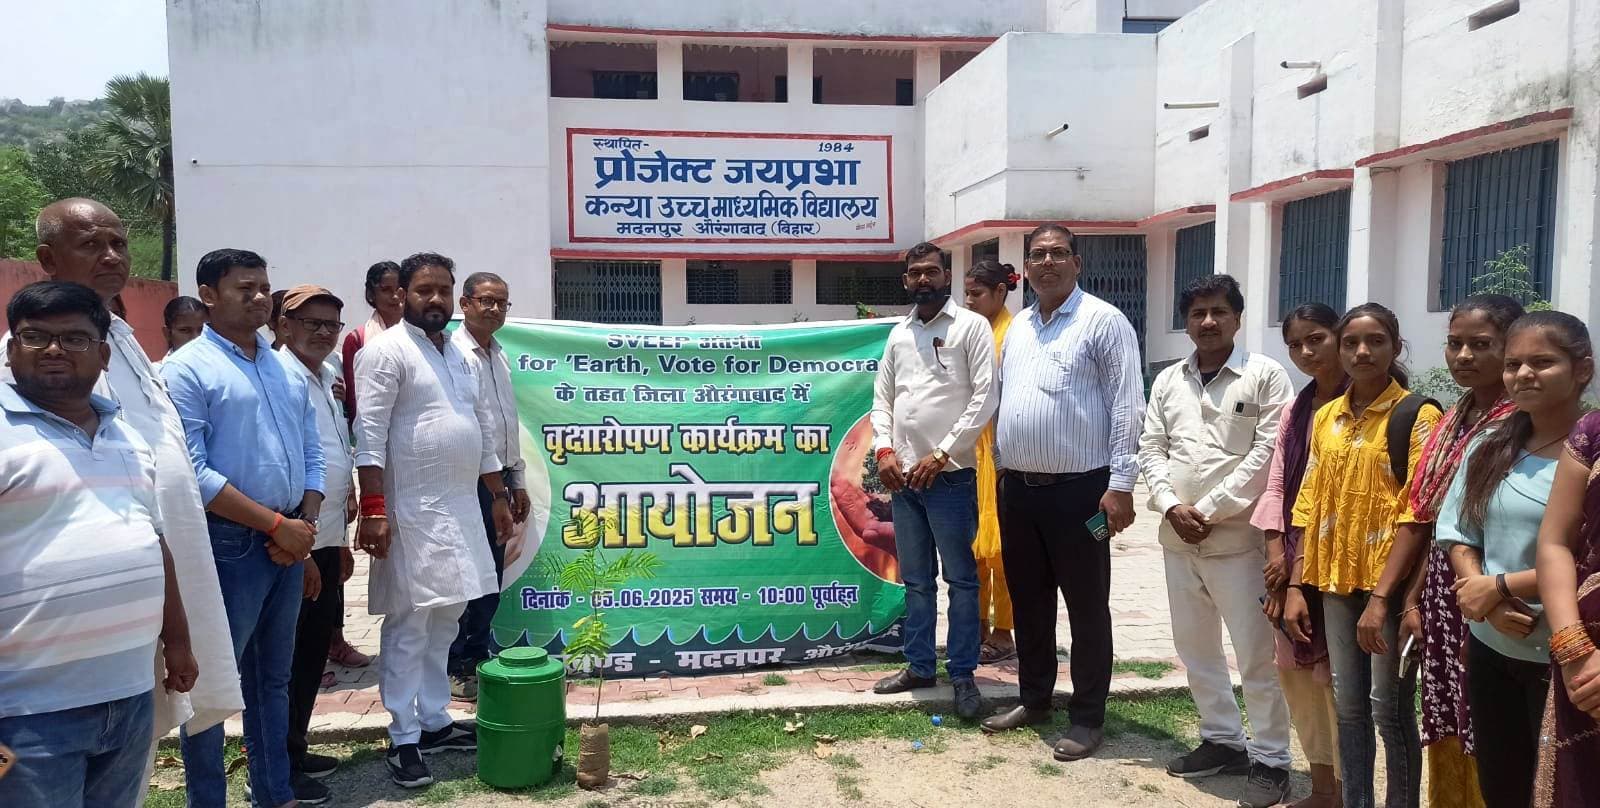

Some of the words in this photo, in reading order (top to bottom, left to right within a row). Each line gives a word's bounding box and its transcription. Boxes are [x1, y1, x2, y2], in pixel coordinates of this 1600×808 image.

[818, 141, 854, 153] 1984
[594, 149, 716, 189] प्रोजेक्ट
[724, 159, 860, 191] जयप्रभा
[585, 195, 652, 219] कन्या
[658, 195, 713, 219] उच्च
[714, 190, 799, 219] माध्यमिक
[800, 190, 879, 220] विद्यालय
[617, 222, 683, 237] मदनपुर
[692, 217, 766, 236] औरंगाबाद
[771, 220, 822, 237] (बिहार)
[608, 334, 690, 348] SVEEP
[519, 355, 556, 371] for
[566, 355, 650, 376] 'Earth,
[659, 356, 716, 373] Vote
[725, 355, 761, 373] for
[769, 356, 879, 373] Democra
[554, 382, 577, 402] के
[583, 387, 626, 402] तहत
[633, 384, 687, 402] जिला
[694, 385, 786, 402] औरंगाबाद
[792, 384, 811, 402] में
[543, 417, 672, 464] वृक्षारोपण
[679, 417, 785, 455] कार्यक्रम
[792, 423, 831, 455] का
[562, 464, 820, 549] आयोजन
[521, 586, 571, 609] दिनांक
[591, 589, 694, 608] 05.06.2025
[700, 588, 738, 604] समय
[759, 588, 804, 603] 10:00
